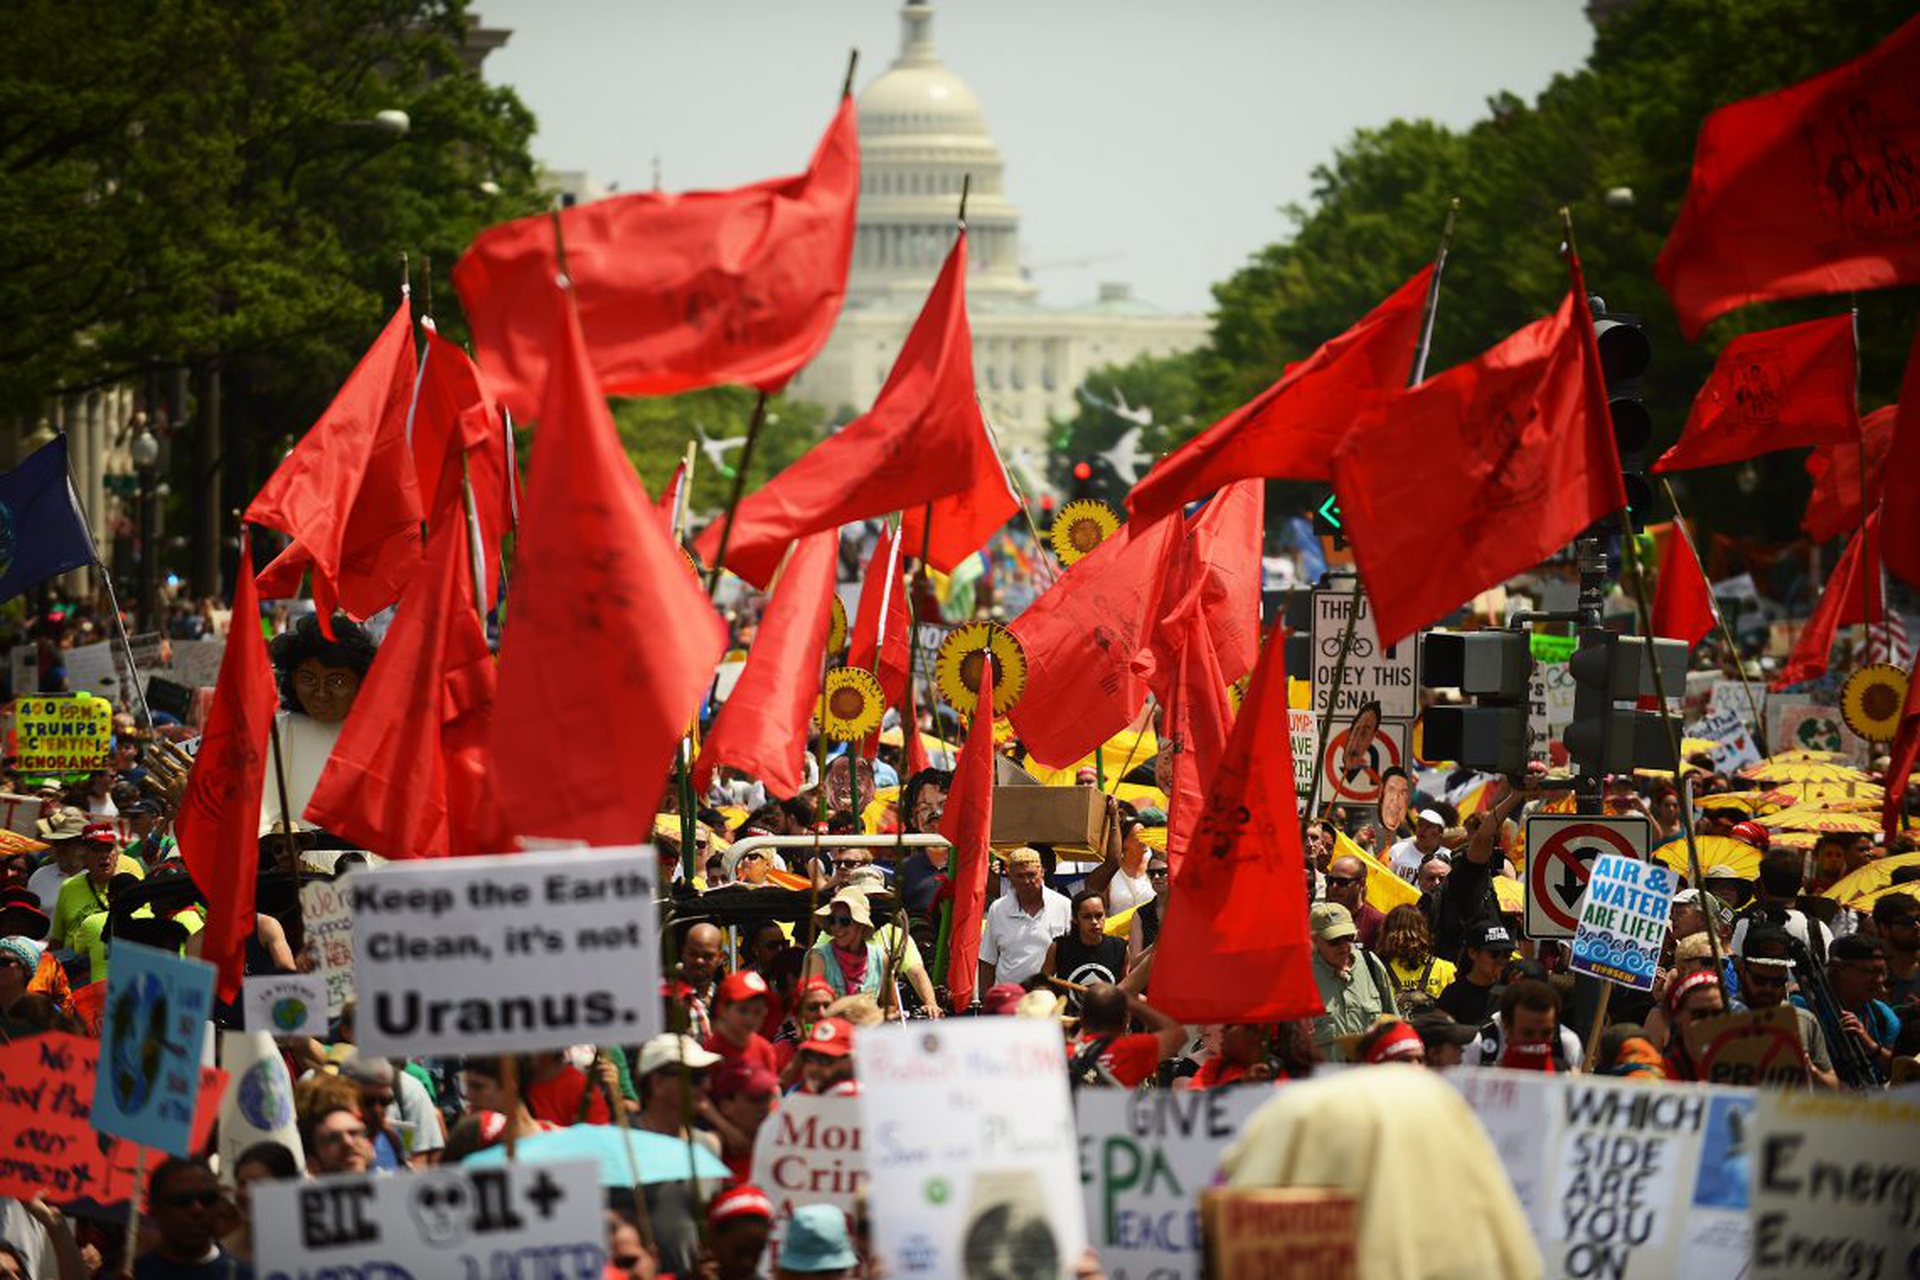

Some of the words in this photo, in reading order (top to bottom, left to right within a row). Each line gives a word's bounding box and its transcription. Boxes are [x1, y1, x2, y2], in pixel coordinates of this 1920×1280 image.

[1320, 600, 1367, 620] THRU
[1373, 667, 1411, 687] THIS
[21, 702, 56, 715] 400
[1318, 690, 1375, 710] SGNA
[24, 722, 97, 736] TRUMPS
[1289, 713, 1313, 731] UMP:
[17, 755, 109, 770] IGNORANCE
[1291, 735, 1312, 755] AVE
[353, 884, 454, 916] Keep
[467, 880, 532, 908] the
[545, 873, 649, 902] Earth
[1594, 857, 1641, 886] AIR
[1644, 868, 1671, 896] &
[1590, 878, 1669, 921] WATER
[367, 931, 493, 963] Clean,
[504, 924, 564, 954] it's
[577, 922, 639, 950] not
[1582, 902, 1618, 931] ARE
[1620, 913, 1665, 945] LIFE!
[375, 989, 639, 1036] Uranus.
[1126, 1090, 1234, 1138] GIVE
[1565, 1083, 1705, 1134] WHICH
[1568, 1131, 1669, 1178] SIDE
[1565, 1168, 1652, 1211] ARE
[1562, 1203, 1655, 1246] YOU
[1563, 1243, 1631, 1280] ON
